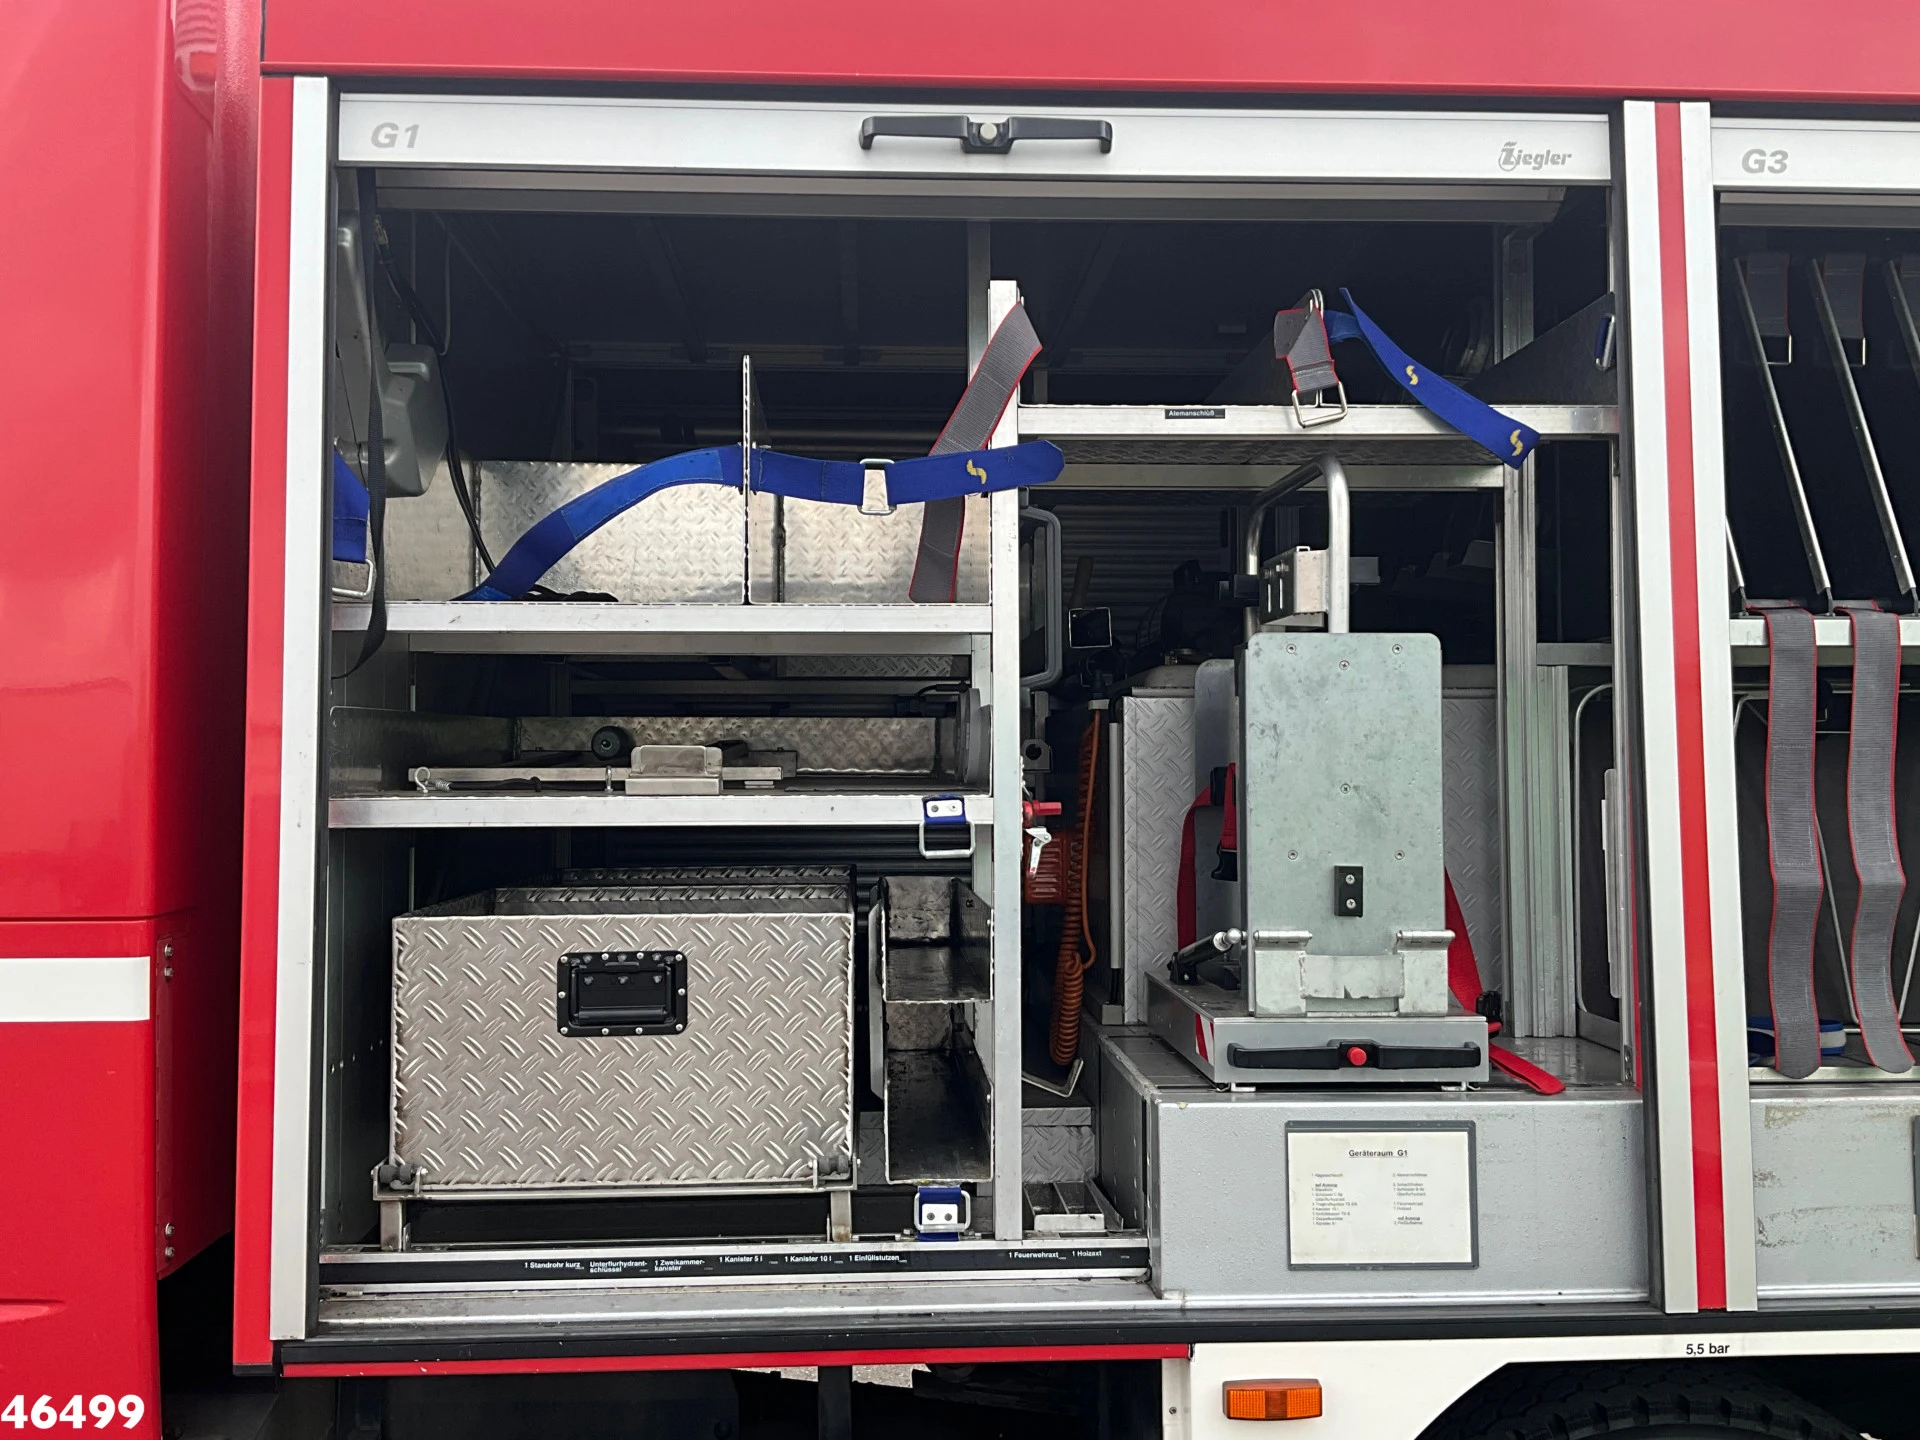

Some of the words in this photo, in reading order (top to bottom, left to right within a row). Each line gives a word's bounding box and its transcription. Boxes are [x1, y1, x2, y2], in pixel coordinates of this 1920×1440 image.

[371, 122, 420, 148] G1
[1498, 141, 1572, 171] Ziegler
[1742, 148, 1789, 173] G3
[1397, 1149, 1408, 1157] G1
[1686, 1343, 1704, 1356] 5,5
[1709, 1343, 1730, 1354] bar
